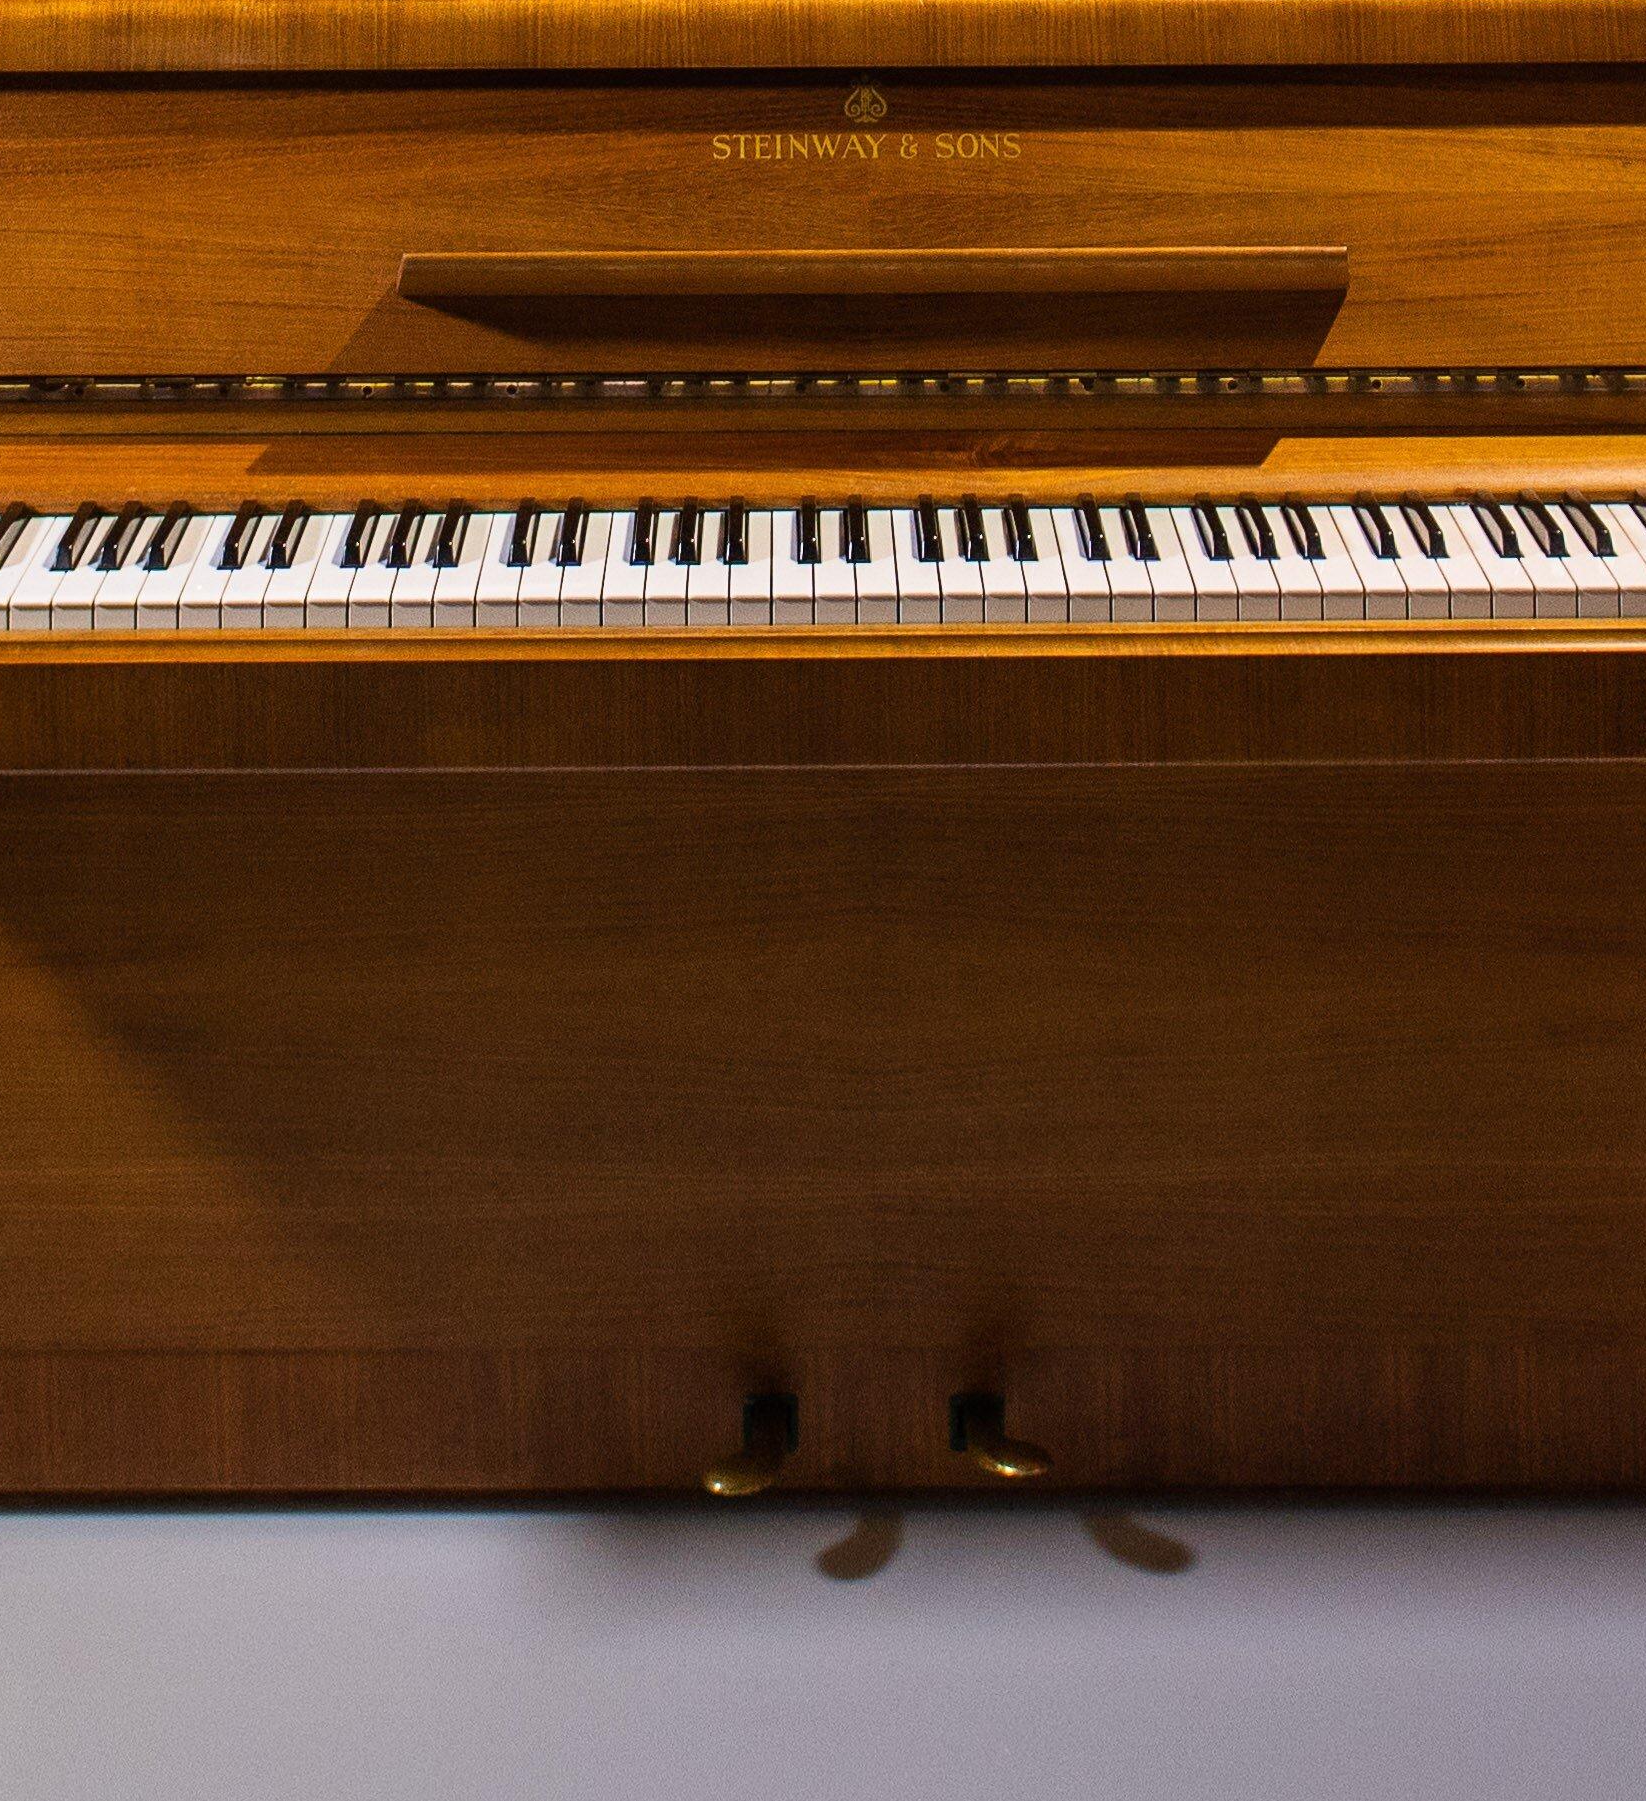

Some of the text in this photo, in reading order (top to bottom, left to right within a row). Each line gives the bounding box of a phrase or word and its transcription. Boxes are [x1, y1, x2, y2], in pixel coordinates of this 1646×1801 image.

[712, 132, 1022, 160] STEINWAY & SONS
